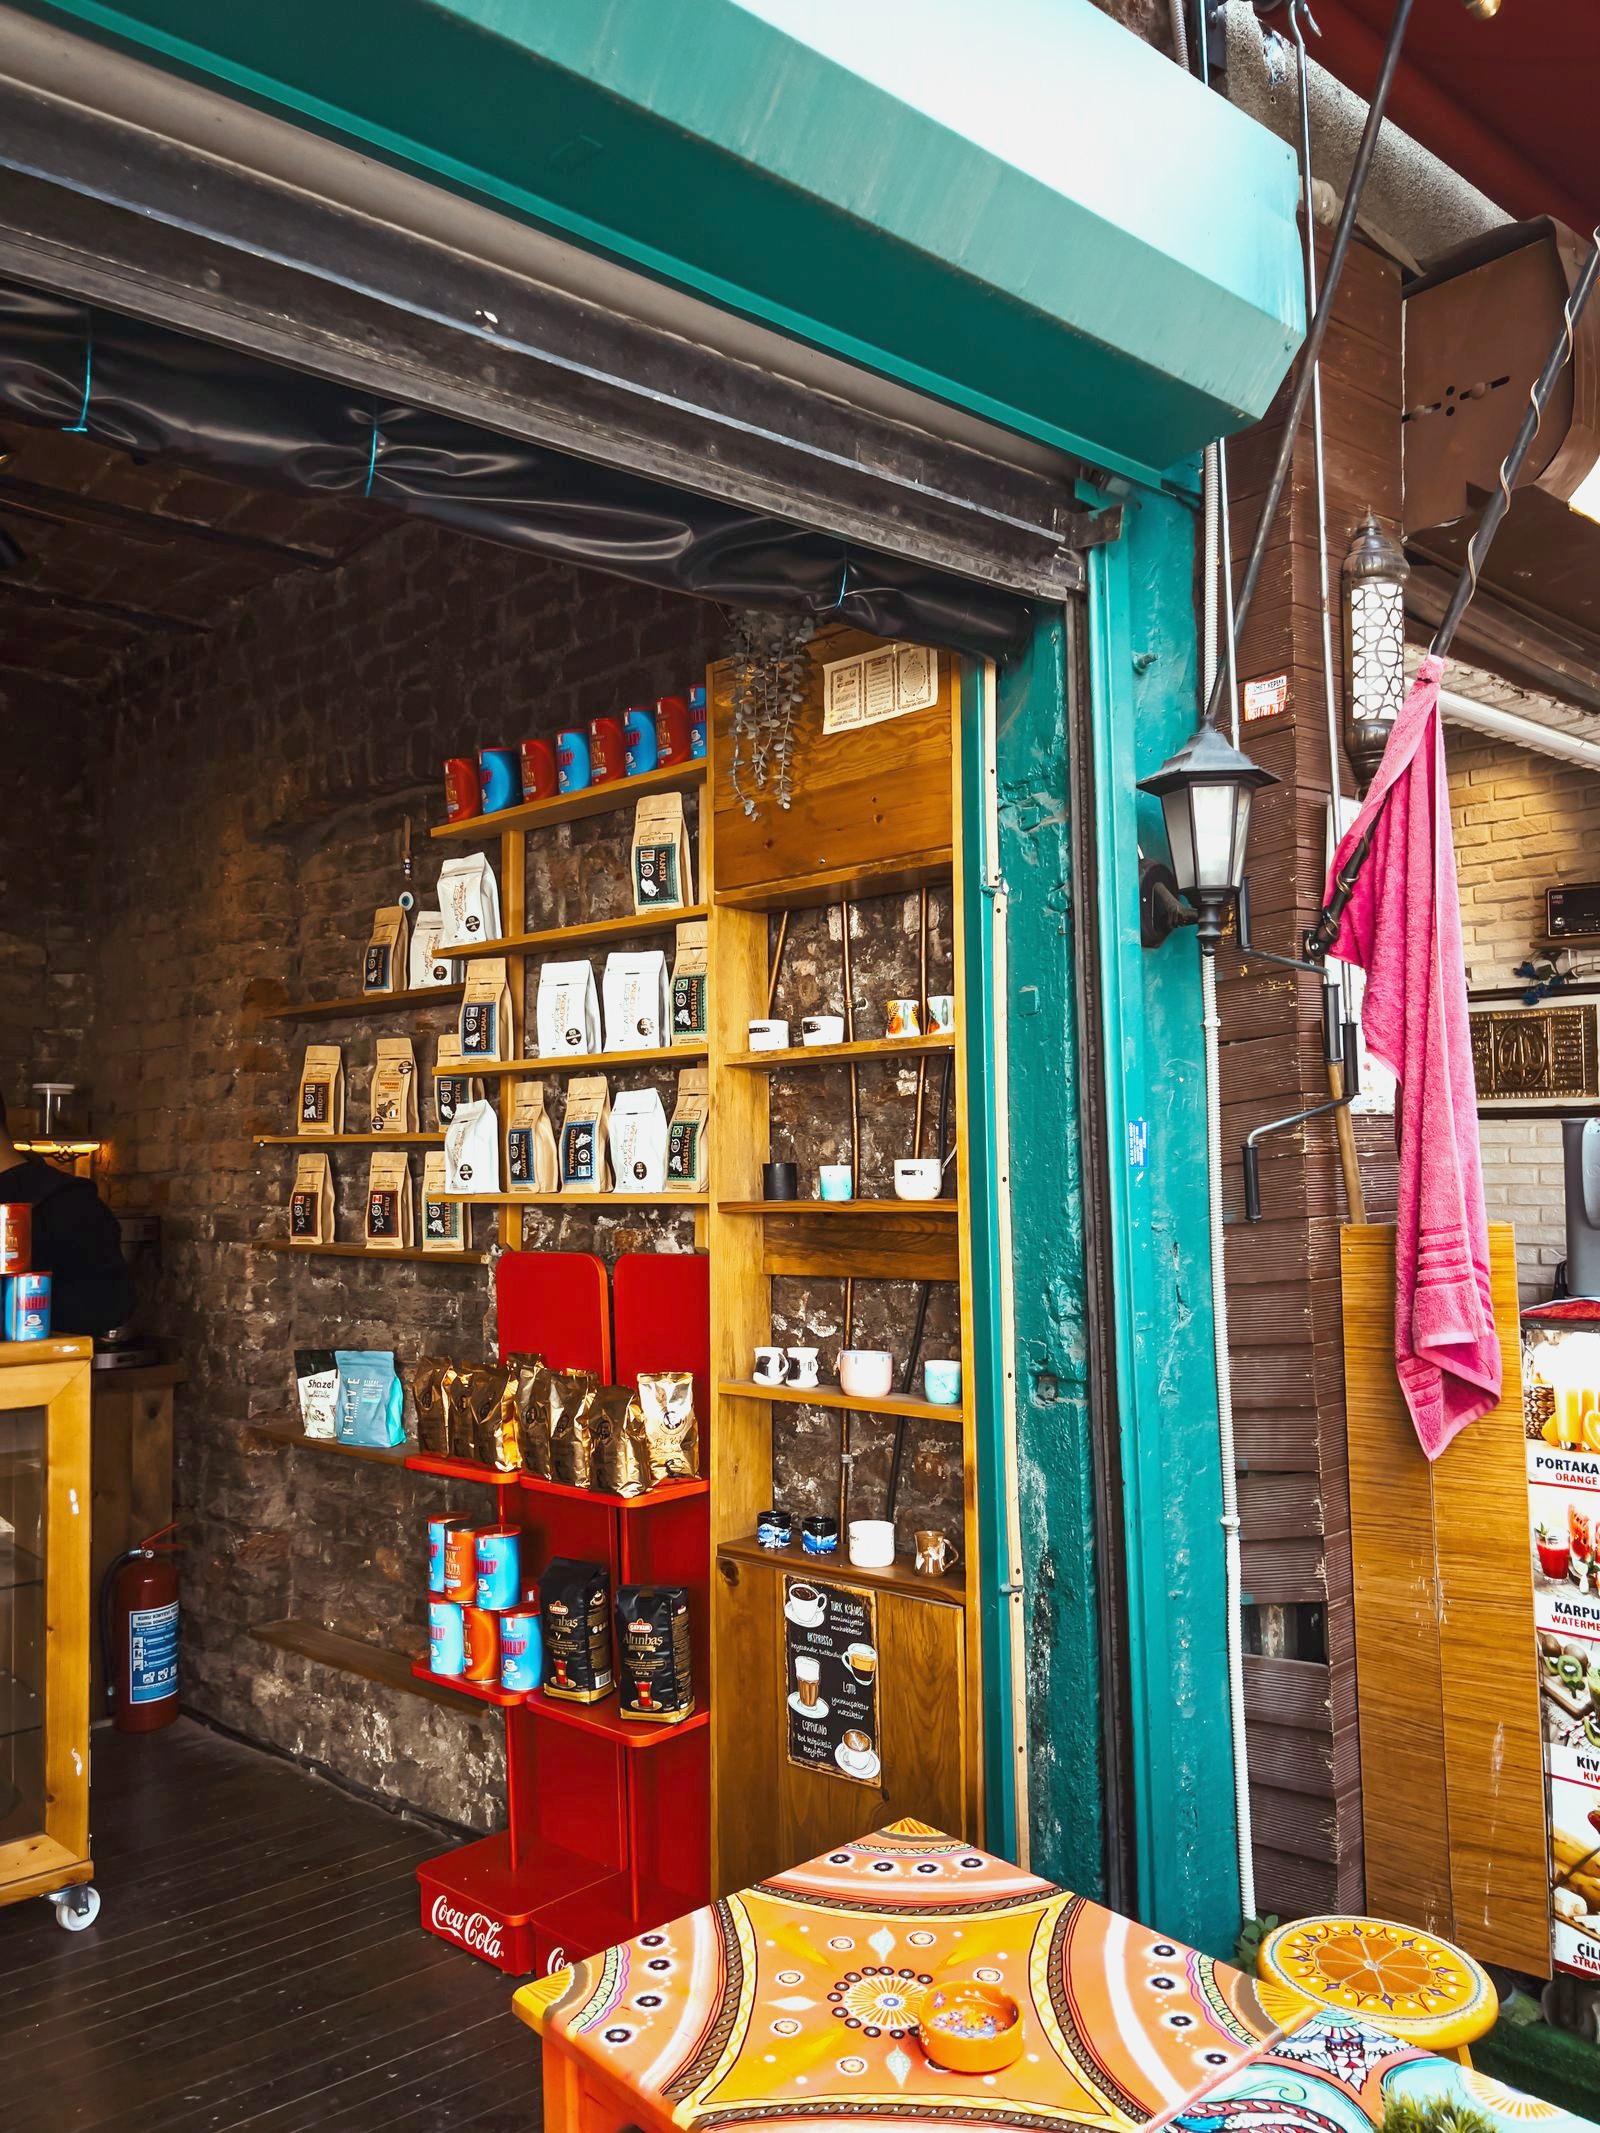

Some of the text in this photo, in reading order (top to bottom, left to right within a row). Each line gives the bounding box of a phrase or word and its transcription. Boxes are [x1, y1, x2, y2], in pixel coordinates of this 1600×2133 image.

[659, 851, 667, 882] KENYA
[454, 1081, 462, 1104] ENYA
[307, 1378, 335, 1390] Shazel
[1555, 1472, 1598, 1486] ORANGE
[1554, 1601, 1600, 1620] KARPU
[431, 1894, 504, 1960] Coca-Cola
[1576, 1941, 1600, 1961] ÇİL
[1572, 1954, 1600, 1971] STRA
